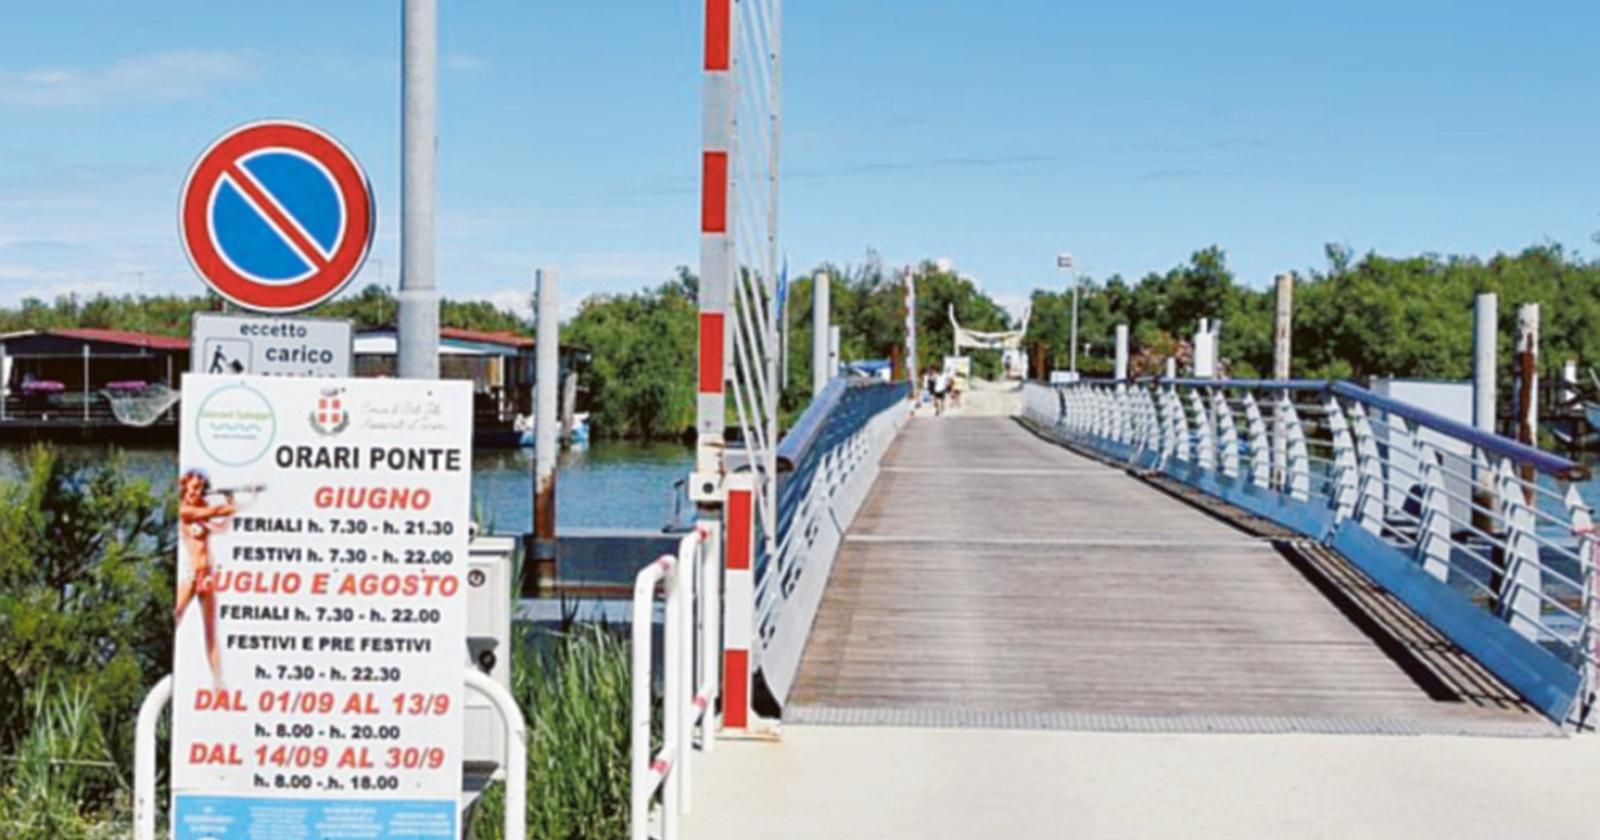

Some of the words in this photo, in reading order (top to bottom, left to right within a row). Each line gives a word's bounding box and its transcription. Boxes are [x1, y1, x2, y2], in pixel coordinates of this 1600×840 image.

[240, 322, 308, 339] eccetto
[266, 344, 333, 364] carico
[276, 446, 359, 469] ORARI
[370, 448, 461, 470] PONTE
[314, 487, 431, 510] GIUGNO
[233, 518, 302, 532] FERIALI
[308, 519, 324, 533] h.
[330, 520, 366, 534] 7.30
[383, 520, 399, 534] h.
[404, 521, 454, 535] 21.30
[233, 548, 302, 562] FESTIVI
[308, 548, 324, 562] h.
[330, 549, 366, 563] 7.30
[383, 550, 399, 564] h.
[404, 550, 454, 564] 22.00
[311, 574, 330, 594] E
[339, 574, 459, 596] AGOSTO
[220, 606, 289, 621] FERIALI
[295, 607, 310, 621] h.
[316, 607, 353, 622] 7.30
[370, 608, 385, 622] h.
[392, 608, 440, 623] 22.00
[227, 636, 296, 650] FESTIVI
[302, 637, 313, 650] E
[319, 637, 354, 651] PRE
[361, 638, 431, 652] FESTIVI
[255, 666, 271, 679] h.
[277, 666, 314, 680] 7.30
[330, 667, 346, 681] h.
[352, 667, 400, 682] 22.30
[194, 690, 247, 712] DAL
[259, 691, 334, 713] 01/09
[343, 693, 380, 714] AL
[392, 694, 450, 715] 13/9
[255, 724, 270, 738] h.
[276, 725, 313, 738] 8.00
[330, 726, 345, 739] h.
[351, 726, 400, 739] 20.00
[188, 744, 242, 764] DAL
[255, 745, 328, 766] 14/09
[337, 747, 373, 768] AL
[385, 748, 445, 769] 30/9
[254, 775, 269, 787] h.
[274, 776, 312, 789] 8.00
[328, 777, 344, 789] h.
[351, 777, 398, 789] 18.00
